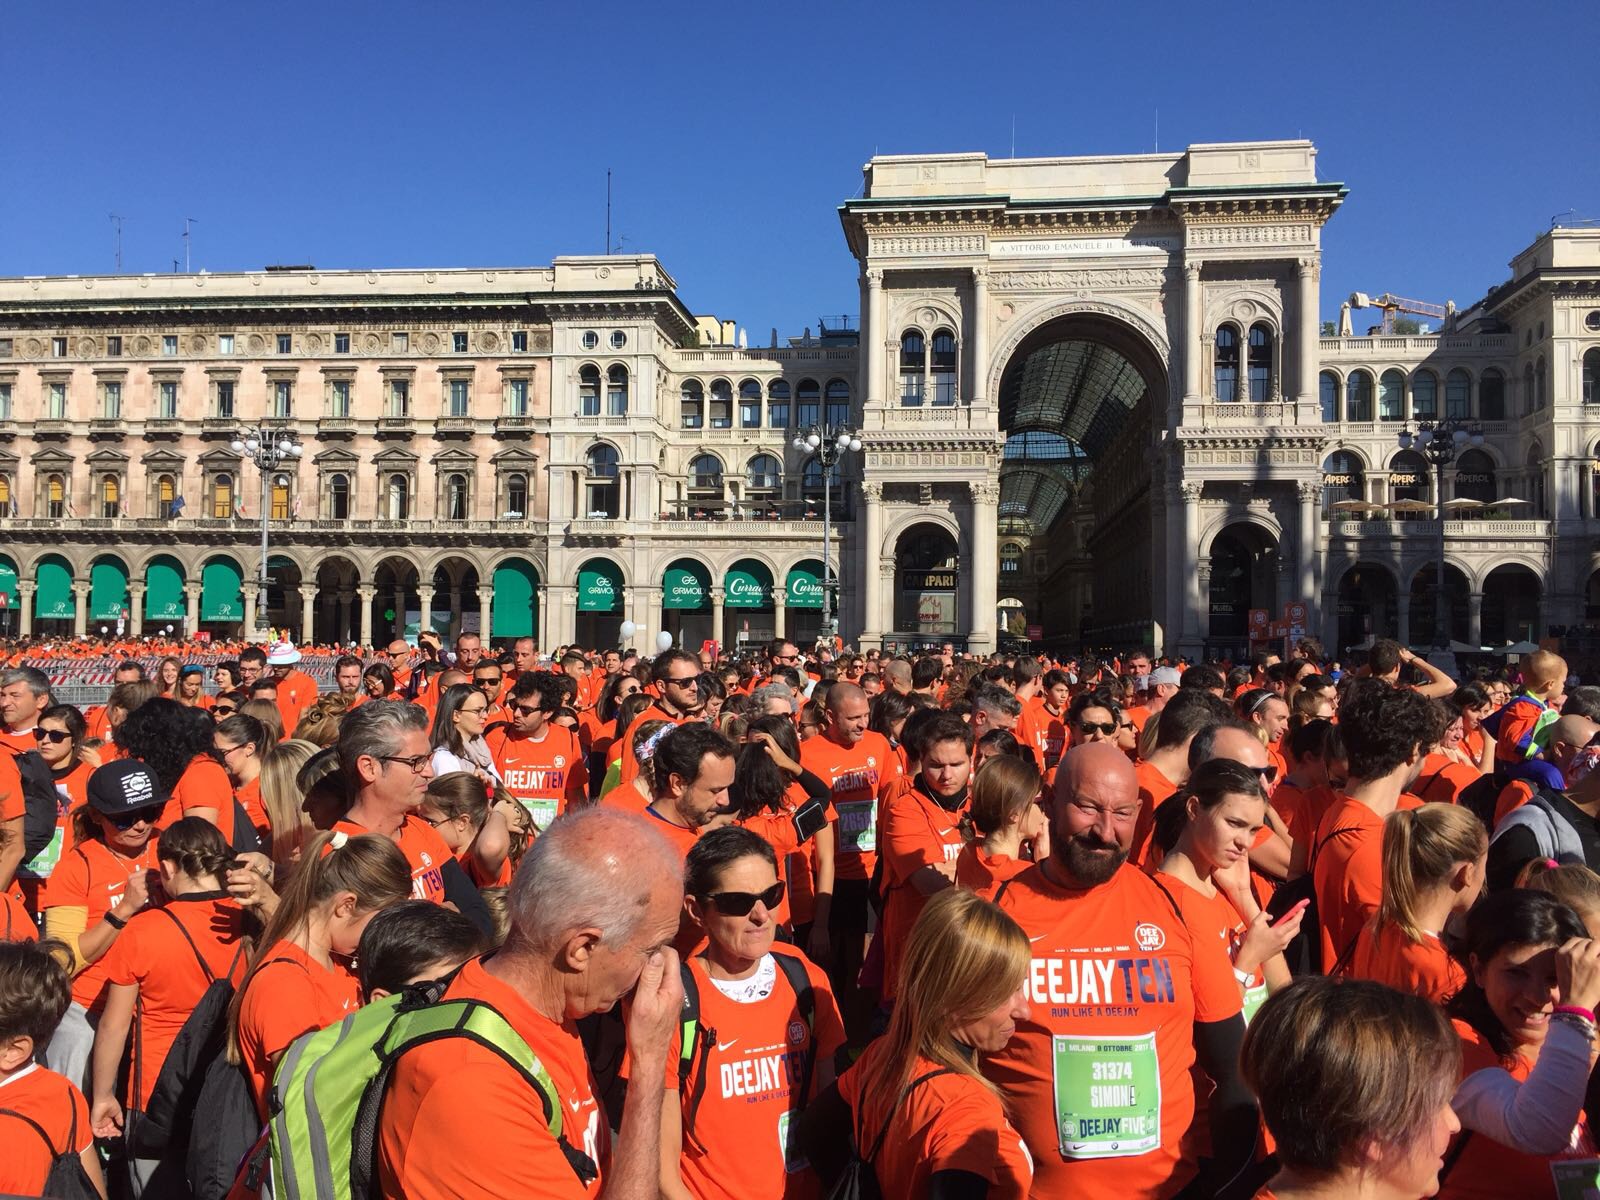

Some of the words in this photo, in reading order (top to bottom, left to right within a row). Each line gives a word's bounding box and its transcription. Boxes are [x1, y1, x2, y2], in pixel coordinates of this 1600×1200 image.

[1011, 244, 1050, 252] VITTORIO
[1054, 243, 1102, 251] EMANUELE
[1130, 239, 1170, 248] MILANESI
[1456, 473, 1489, 483] APEROL
[792, 578, 824, 596] Curra
[1139, 927, 1159, 937] DEE
[1141, 936, 1160, 946] JAY
[1051, 1007, 1070, 1018] RUN
[1072, 1007, 1093, 1017] LIKE
[1096, 1007, 1103, 1017] A
[1105, 1007, 1140, 1017] DEEJAY
[1068, 1043, 1096, 1053] MILANO
[1103, 1044, 1133, 1052] OTTOBRE
[1091, 1061, 1133, 1081] 31374
[1090, 1084, 1137, 1108] SIMONE
